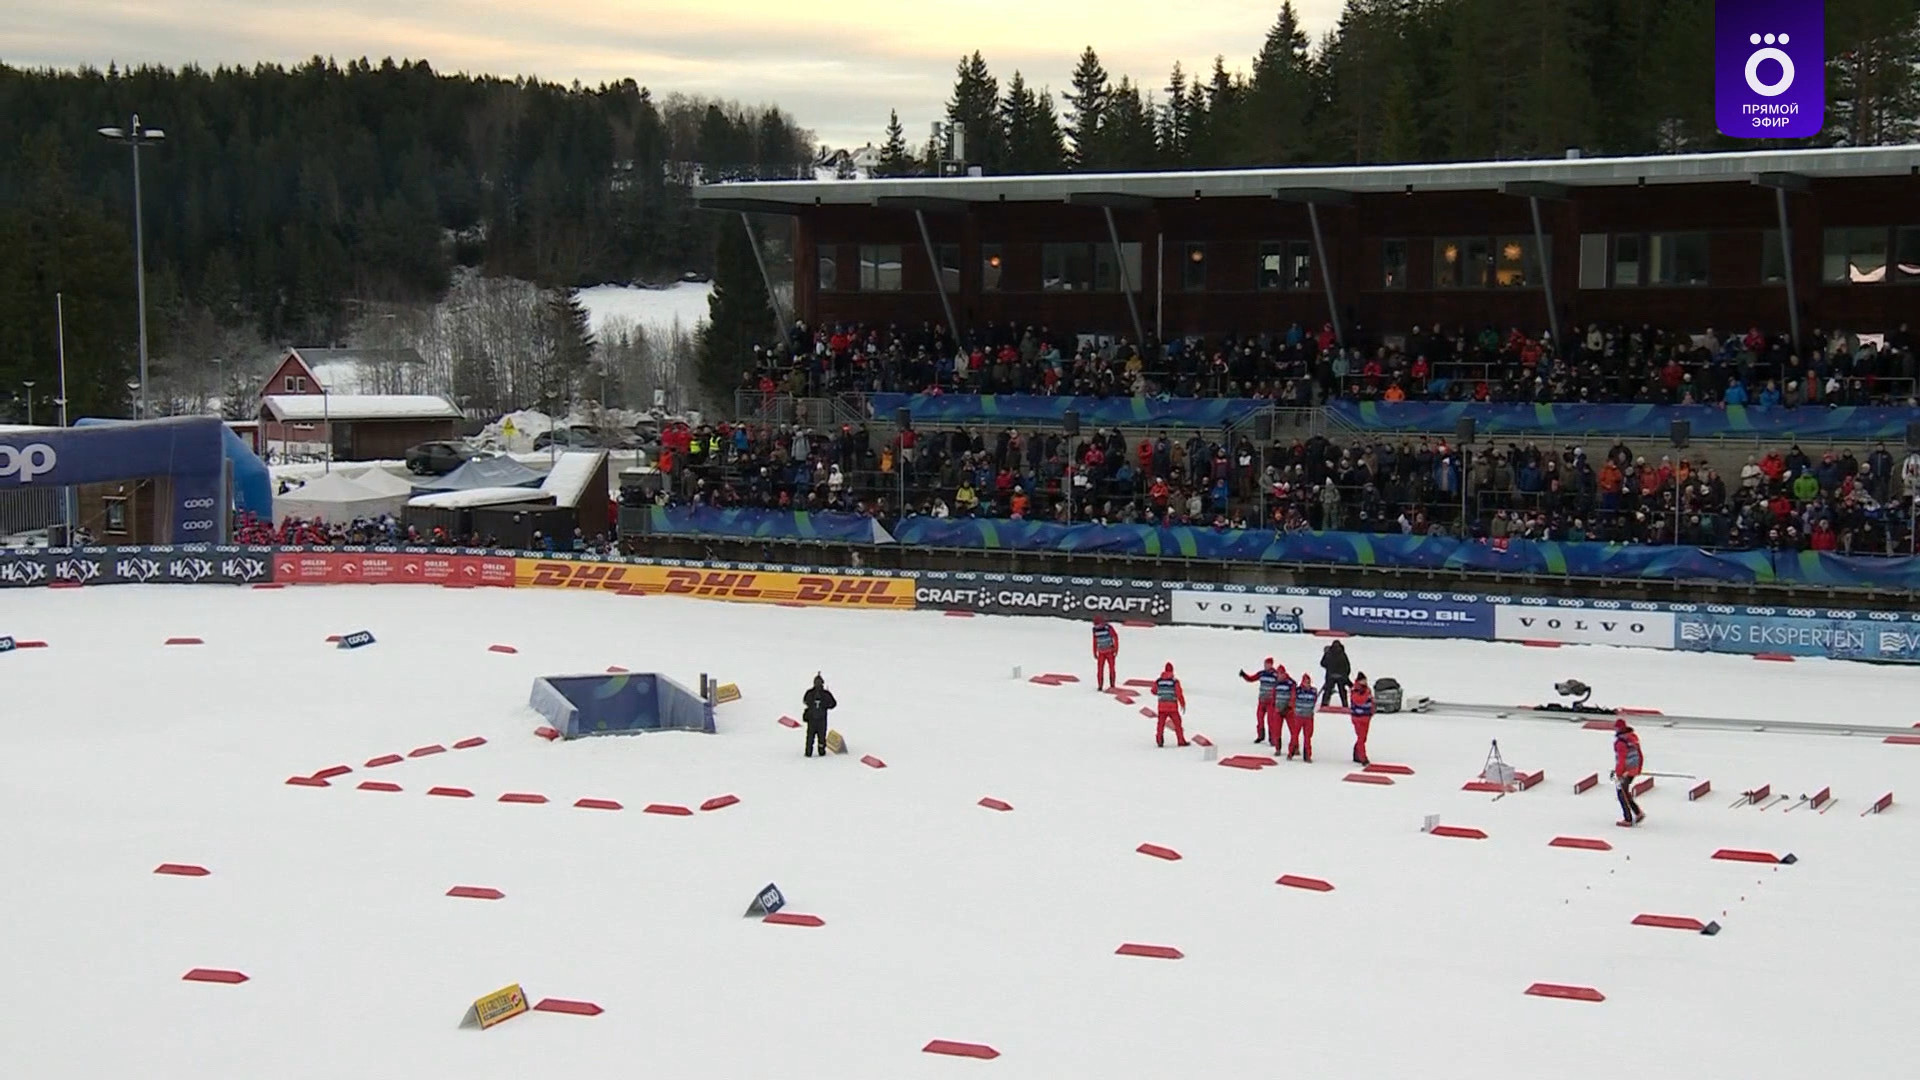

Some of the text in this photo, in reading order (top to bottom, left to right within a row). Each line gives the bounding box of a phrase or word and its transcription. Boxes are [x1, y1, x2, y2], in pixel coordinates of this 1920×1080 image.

[184, 498, 214, 508] coop
[183, 520, 213, 530] coop
[150, 545, 174, 553] coop
[216, 545, 240, 553] coop
[523, 550, 544, 558] coop
[738, 563, 758, 571] coop
[764, 564, 784, 572] coop
[791, 566, 811, 574] coop
[818, 567, 838, 575] coop
[845, 568, 864, 576] coop
[872, 569, 892, 577] coop
[927, 571, 948, 579] coop
[1012, 575, 1033, 583] coop
[1041, 576, 1063, 584] coop
[1071, 577, 1093, 585] coop
[1101, 578, 1123, 587] coop
[1131, 580, 1153, 588] coop
[1161, 581, 1184, 589] coop
[1192, 583, 1215, 591] coop
[1223, 584, 1246, 592] coop
[1255, 585, 1278, 594] coop
[1286, 586, 1309, 595] coop
[1319, 588, 1342, 597] coop
[1352, 589, 1376, 599] coop
[1383, 590, 1408, 600] coop
[1417, 592, 1442, 601] coop
[1452, 593, 1477, 603] coop
[1486, 595, 1511, 604] coop
[1521, 596, 1547, 605] coop
[1558, 599, 1584, 607] coop
[1593, 600, 1620, 609] coop
[1631, 602, 1658, 611] coop
[1669, 604, 1697, 613] coop
[1707, 605, 1735, 615] coop
[1746, 607, 1775, 616] coop
[1787, 607, 1816, 617] coop
[1827, 609, 1857, 620] coop
[1869, 611, 1899, 621] coop
[533, 563, 897, 604] DHL DHL DHL
[916, 588, 1151, 612] CRAFT CRAFT CRAFT
[1196, 602, 1304, 617] VOLVO
[1342, 606, 1476, 622] NARDO BIL
[1269, 622, 1298, 632] coop
[1519, 617, 1645, 633] VOLVO
[1703, 623, 1864, 648] VVS EKSPERTEN
